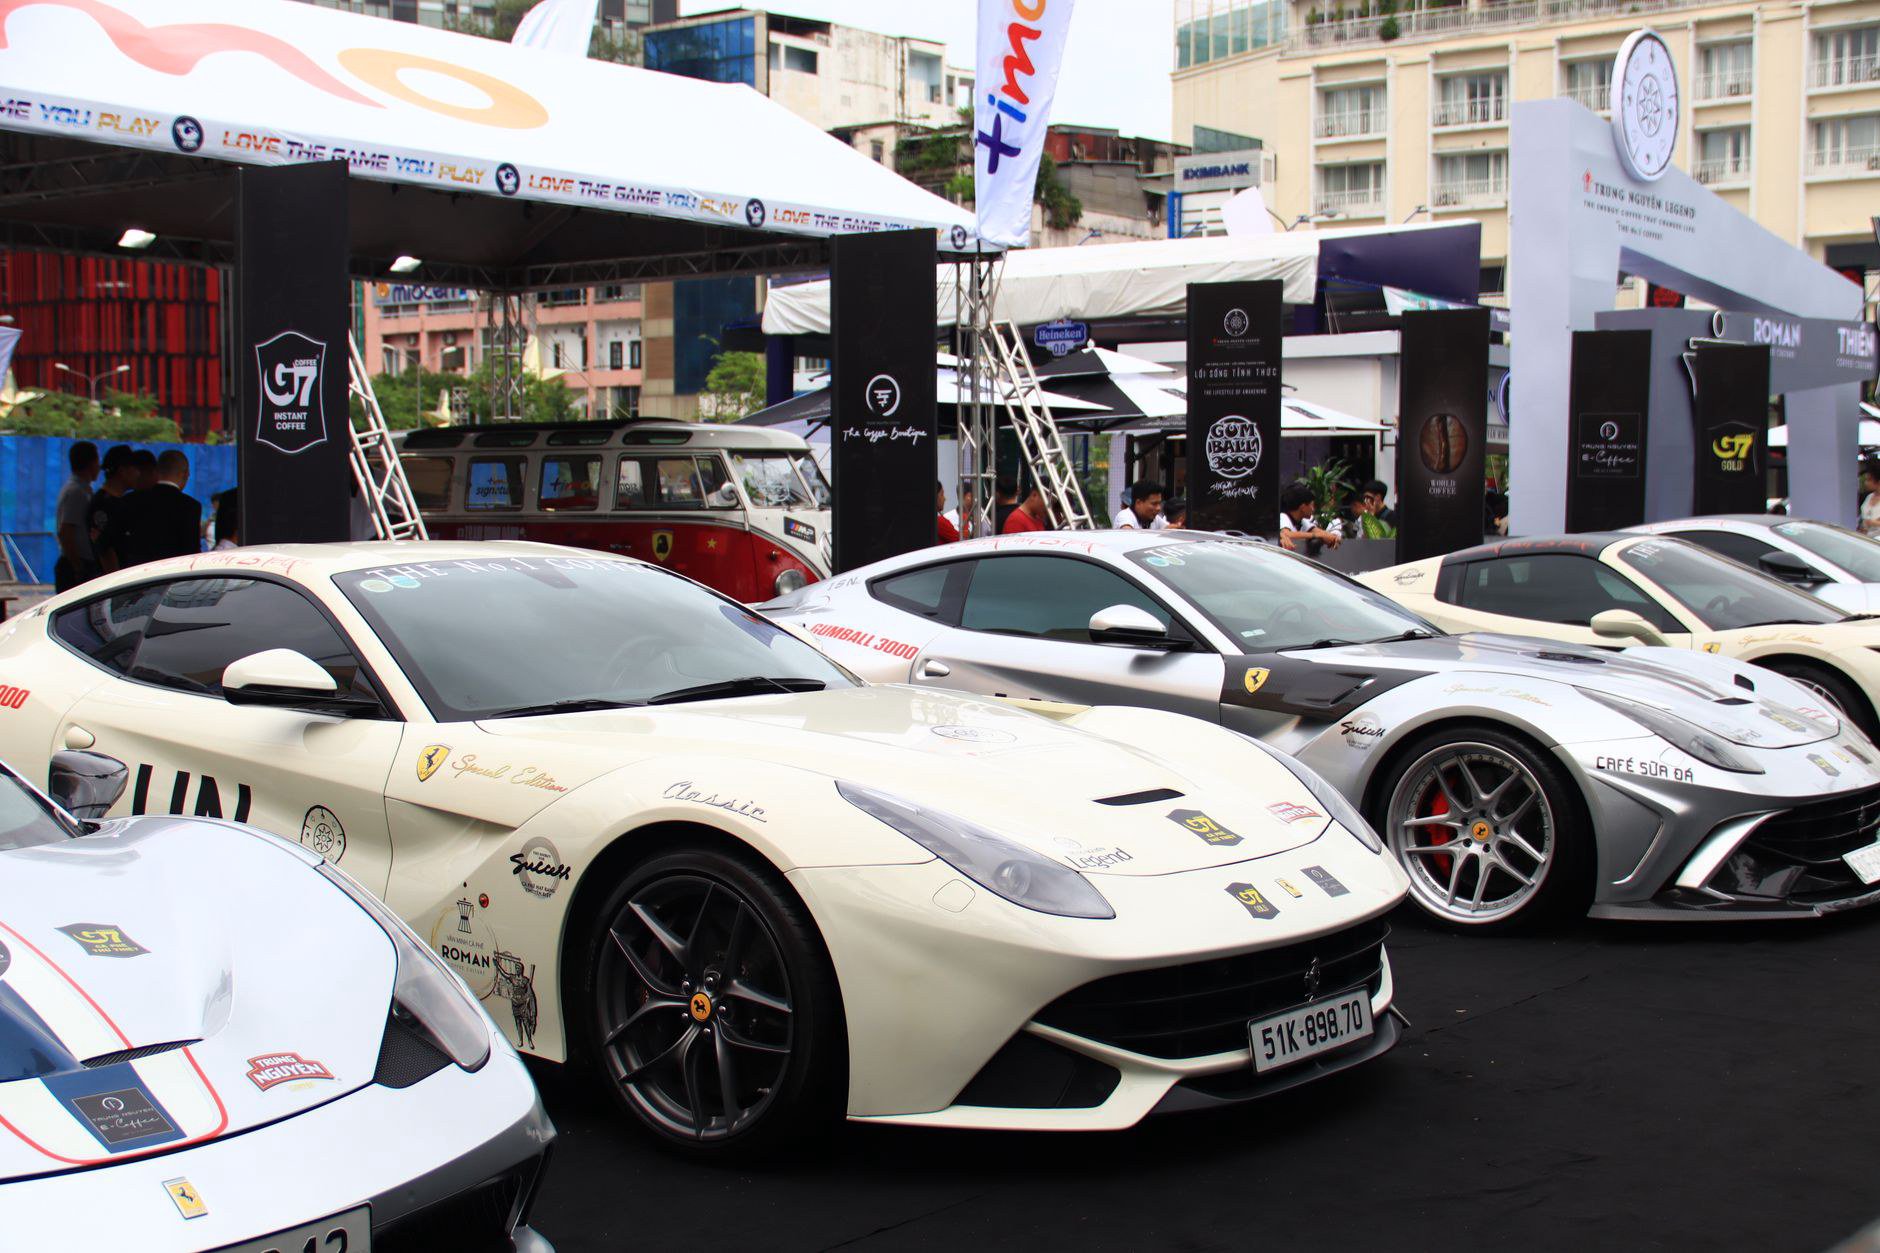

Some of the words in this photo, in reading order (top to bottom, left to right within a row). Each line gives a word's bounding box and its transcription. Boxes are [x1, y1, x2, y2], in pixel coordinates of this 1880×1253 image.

[39, 102, 92, 127] YOU
[97, 111, 160, 138] PLAY
[222, 130, 281, 155] LOVE
[286, 139, 326, 163] THE
[394, 155, 435, 177] YOU
[437, 163, 487, 185] PLAY
[1182, 162, 1250, 180] EXIMBANK
[528, 173, 575, 194] LOVE
[578, 180, 611, 199] THE
[614, 185, 661, 207] GAME
[664, 190, 697, 210] YOU
[699, 198, 739, 218] PLAY
[1583, 199, 1594, 210] THE
[1594, 181, 1625, 201] TRUNG
[1664, 200, 1696, 220] LEGEND
[773, 207, 810, 225] LOVE
[813, 212, 840, 230] THE
[842, 217, 881, 233] GAME
[1039, 327, 1082, 341] Heineken
[1753, 317, 1802, 347] ROMAN
[263, 361, 318, 407] G7
[274, 411, 308, 421] INSTANT
[275, 421, 306, 431] COFFEE
[842, 426, 860, 442] The
[863, 427, 888, 443] Coffee
[889, 425, 928, 446] Boutique
[1210, 438, 1258, 454] BALL
[1712, 433, 1755, 459] G7
[1209, 454, 1258, 472] 3000
[1720, 460, 1743, 471] GOLD
[366, 562, 449, 581] THE
[453, 556, 541, 574] No.1
[810, 623, 875, 648] GUMBALL
[873, 637, 920, 661] 3000
[451, 754, 512, 779] Special
[510, 766, 569, 793] Edition
[1595, 756, 1635, 773] CAFÉ
[509, 853, 572, 881] Success
[1063, 846, 1134, 869] Legend
[441, 944, 490, 969] ROMAN
[1261, 999, 1363, 1061] 51K-898.70
[255, 1055, 298, 1068] TRUNG
